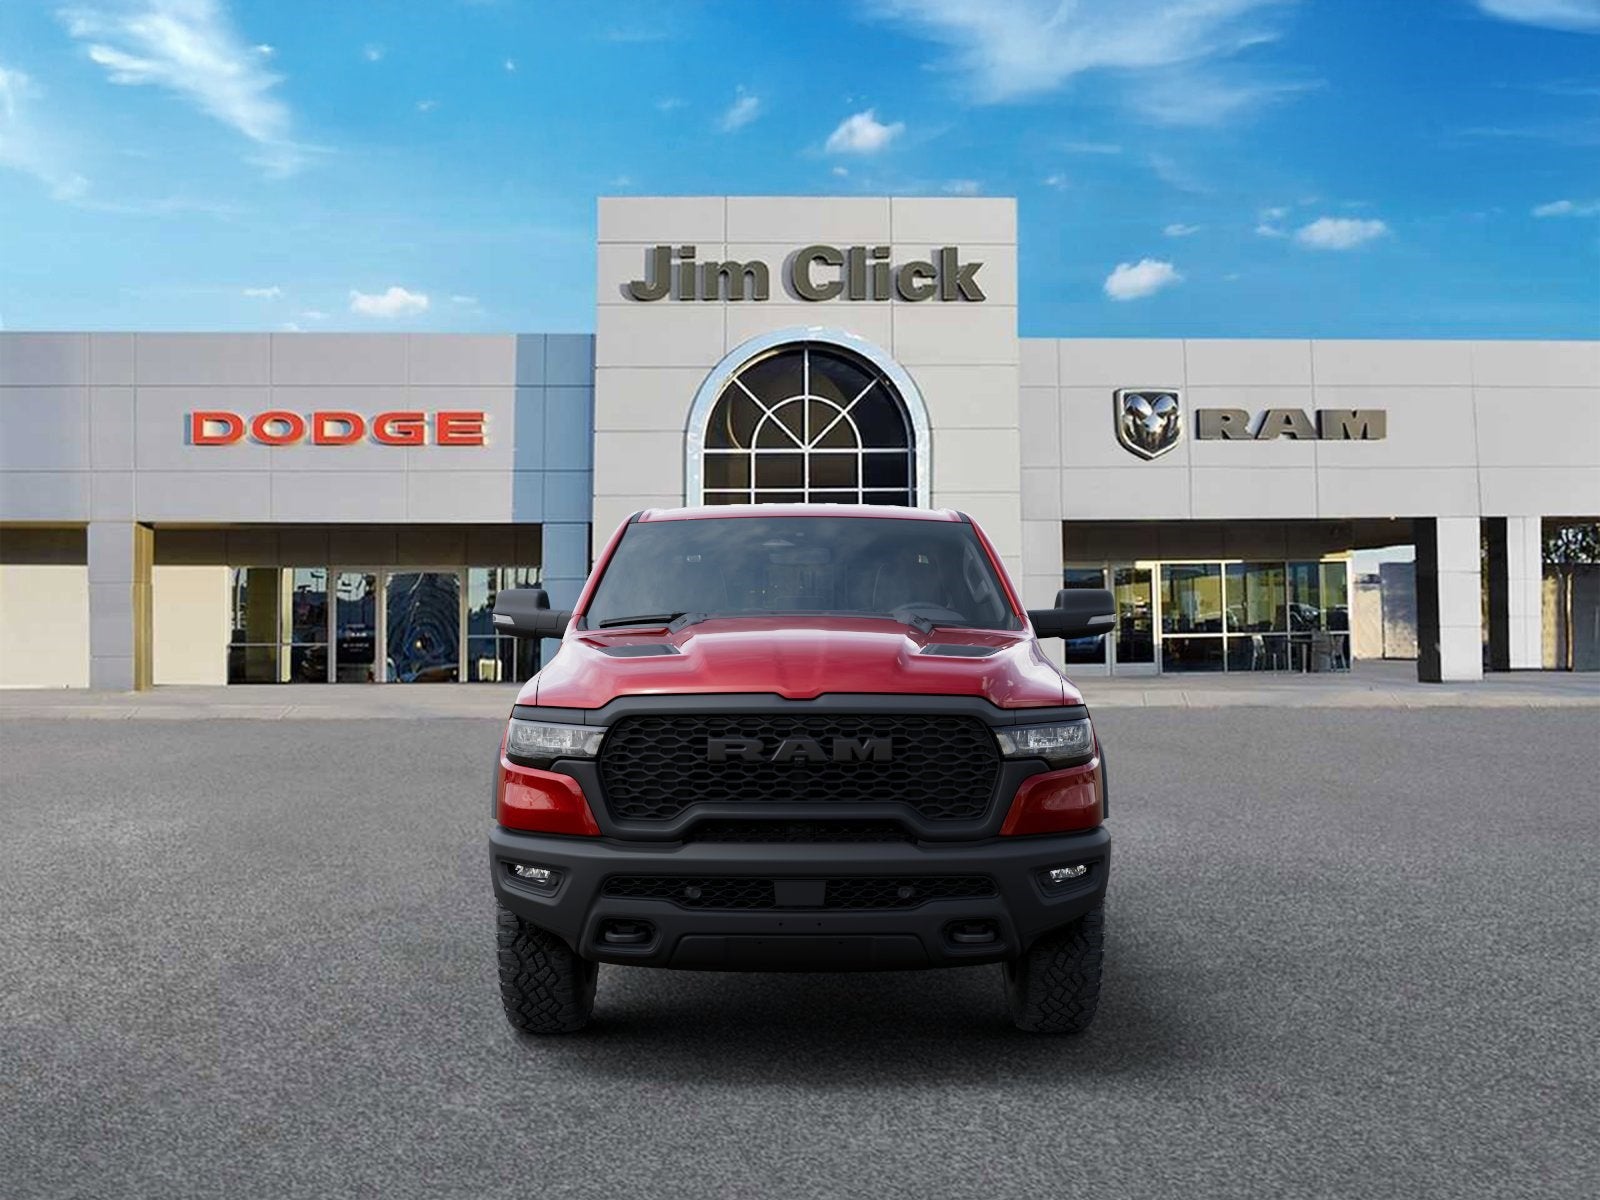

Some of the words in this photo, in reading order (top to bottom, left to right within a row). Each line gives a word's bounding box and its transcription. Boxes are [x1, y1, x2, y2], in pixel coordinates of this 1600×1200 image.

[628, 245, 770, 301] Jim
[790, 245, 986, 302] Click
[190, 410, 486, 446] DODGE
[1195, 408, 1387, 440] RAM
[707, 737, 893, 762] RAM
